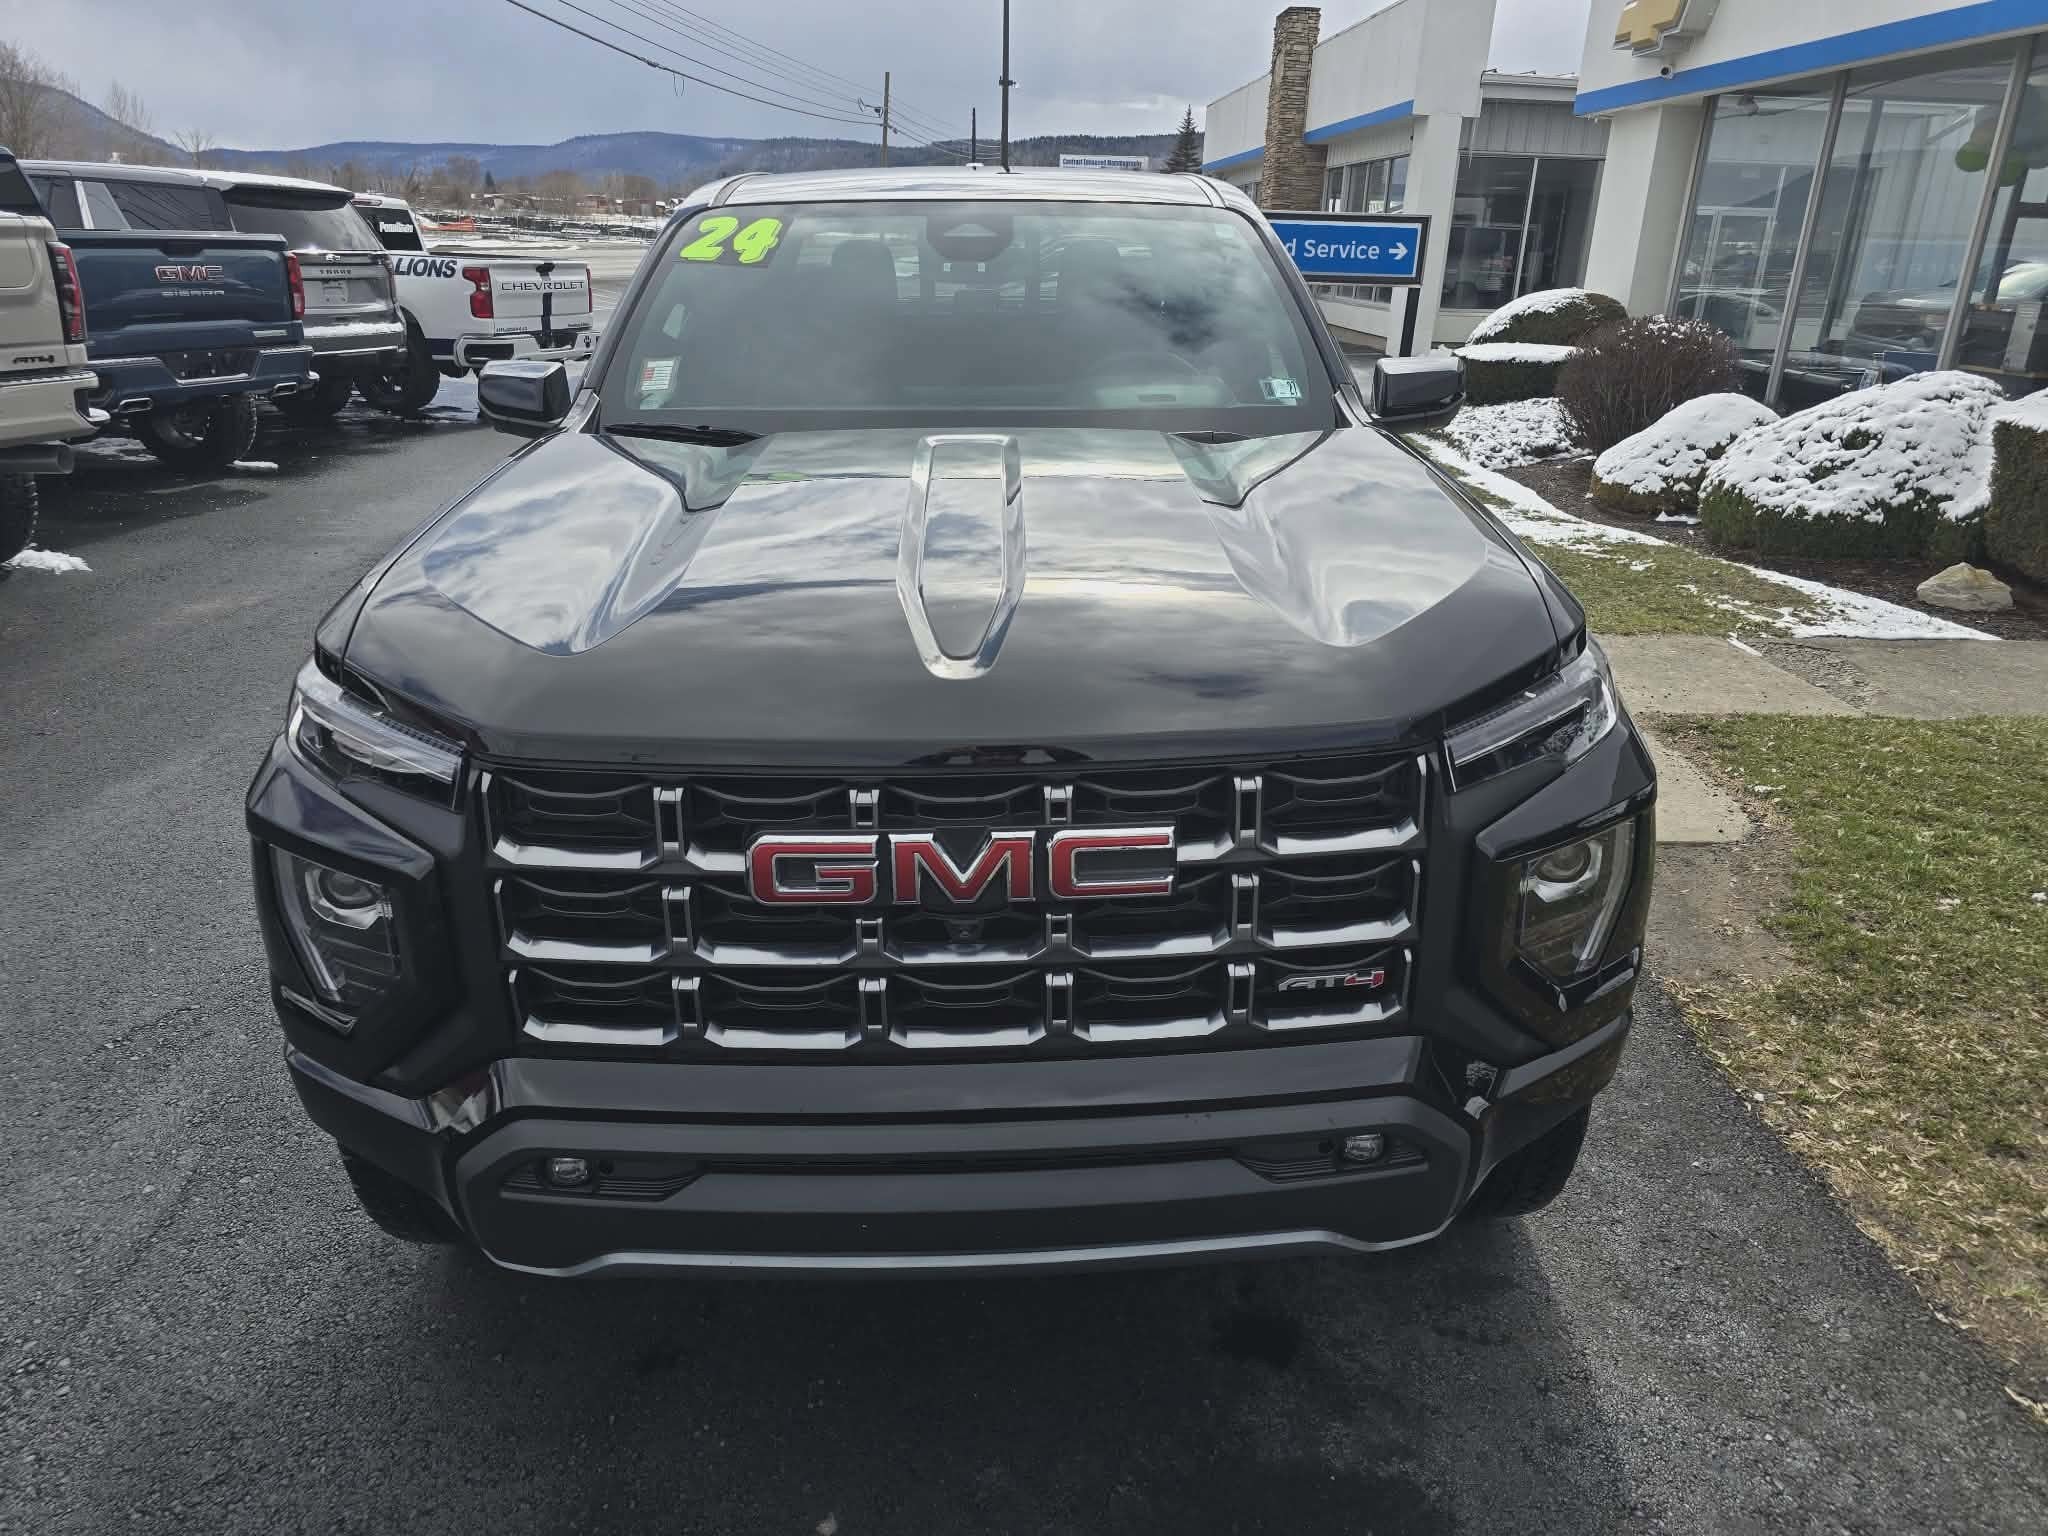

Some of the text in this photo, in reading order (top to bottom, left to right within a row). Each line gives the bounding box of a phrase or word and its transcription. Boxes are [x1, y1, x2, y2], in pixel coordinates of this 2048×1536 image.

[680, 216, 783, 264] 24
[1303, 239, 1380, 260] Service
[154, 265, 224, 282] GMC
[394, 257, 457, 278] LIONS
[501, 281, 585, 291] CHEVROLET
[747, 826, 1175, 905] GMC
[1278, 969, 1385, 993] AT4
